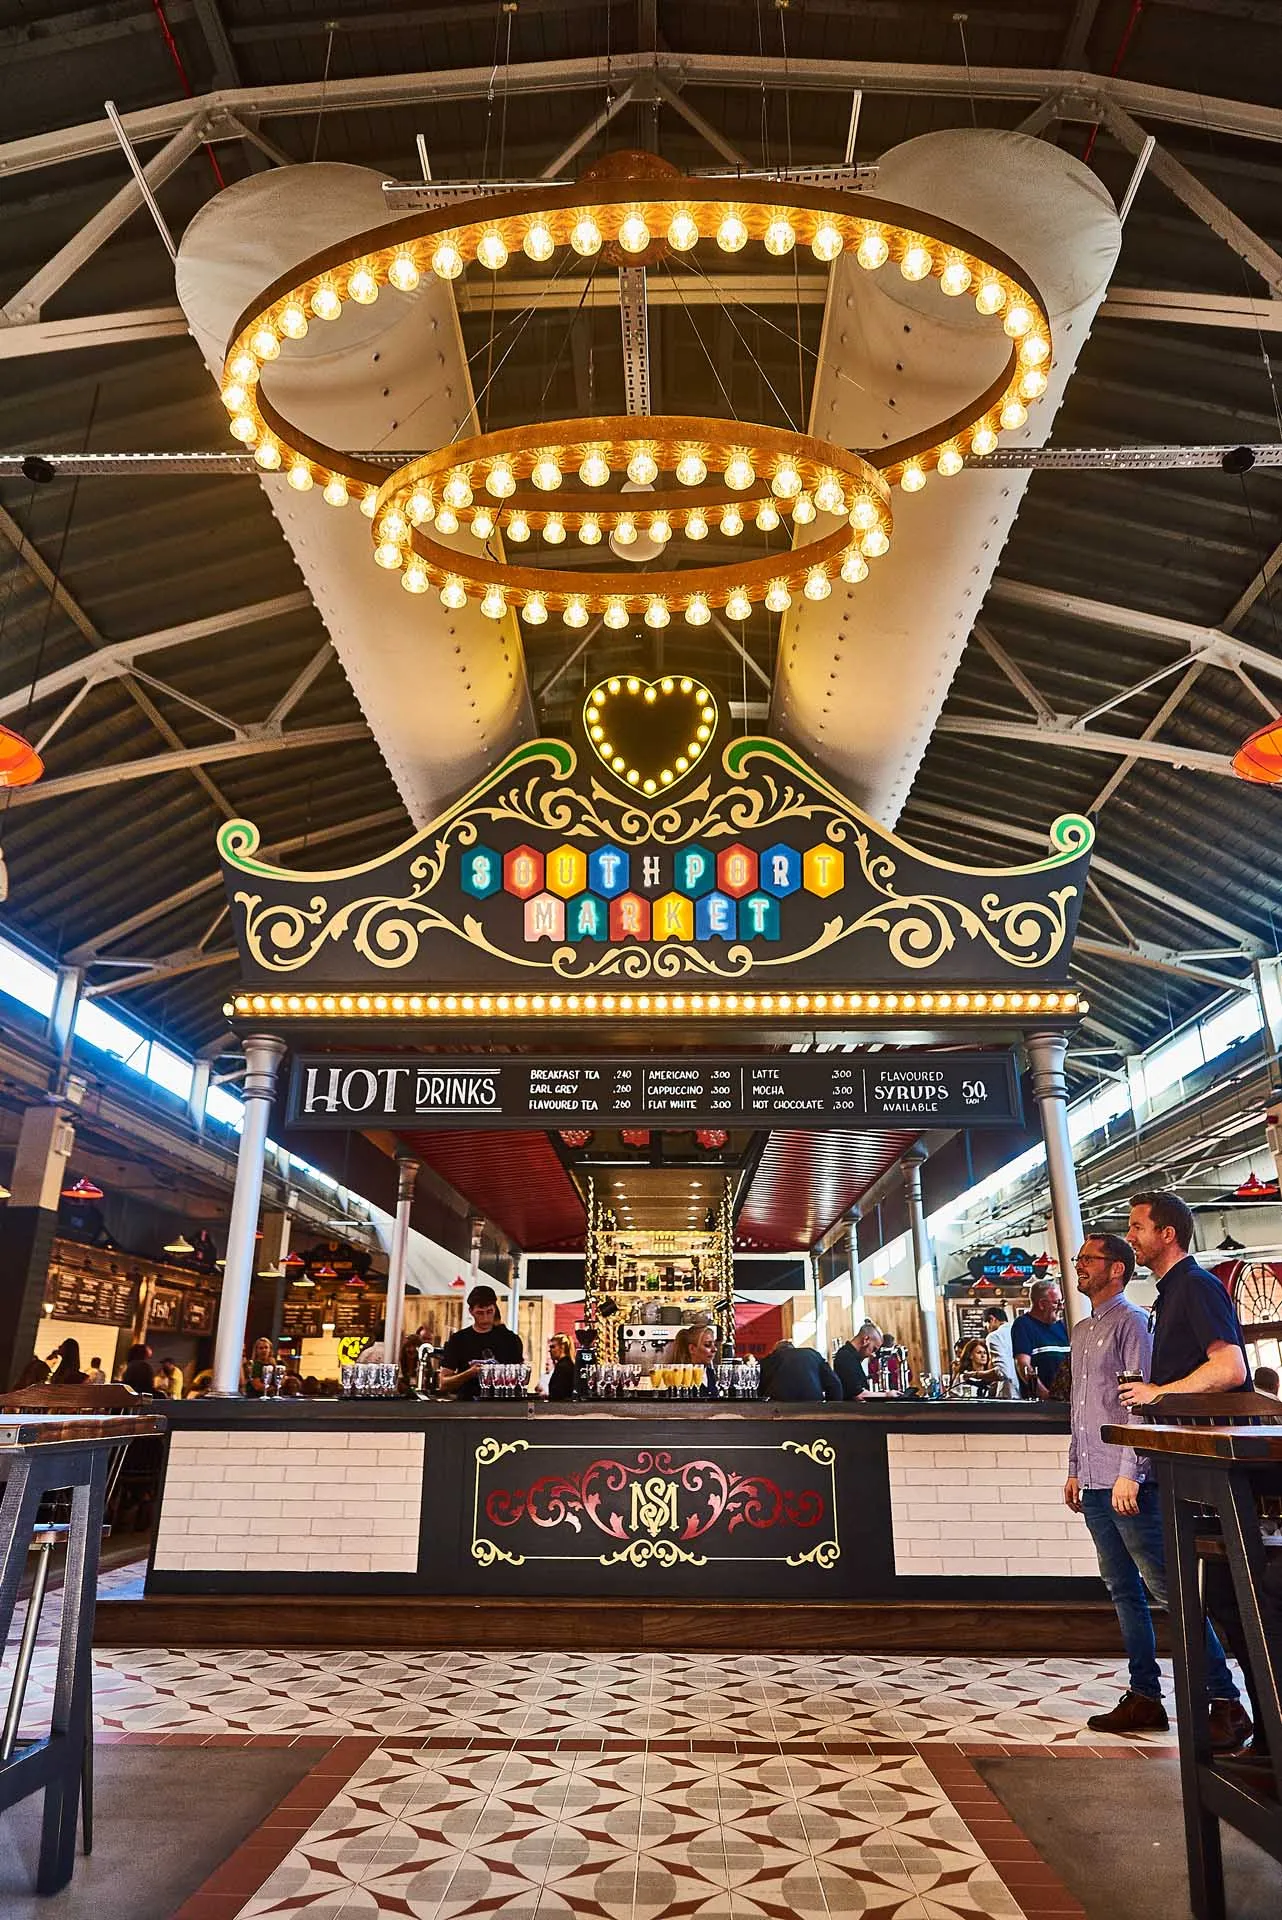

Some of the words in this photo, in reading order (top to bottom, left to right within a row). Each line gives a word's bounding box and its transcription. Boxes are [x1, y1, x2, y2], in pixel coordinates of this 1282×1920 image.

[470, 853, 832, 889] SOUTHPORT
[535, 899, 769, 933] MARKET
[530, 1069, 581, 1080] BREAKFAST
[584, 1070, 600, 1080] TEA
[648, 1070, 700, 1080] AMERICANO
[752, 1069, 780, 1079] LATTE
[880, 1071, 944, 1082] FLAVOURED
[304, 1068, 410, 1113] HOT
[415, 1077, 496, 1105] DRINKS
[529, 1083, 553, 1094] EARL
[555, 1084, 578, 1094] GREY
[647, 1085, 704, 1096] CAPPUCCINO
[752, 1085, 785, 1095] MOCHA
[874, 1085, 949, 1100] SYRUPS
[528, 1099, 579, 1110] FLAVOURED
[581, 1099, 599, 1111] TEA
[648, 1099, 667, 1110] FLAT
[669, 1099, 697, 1109] WHITE
[752, 1099, 769, 1109] HOT
[773, 1099, 825, 1110] CHOCOLATE
[882, 1102, 938, 1112] AVAILABLE
